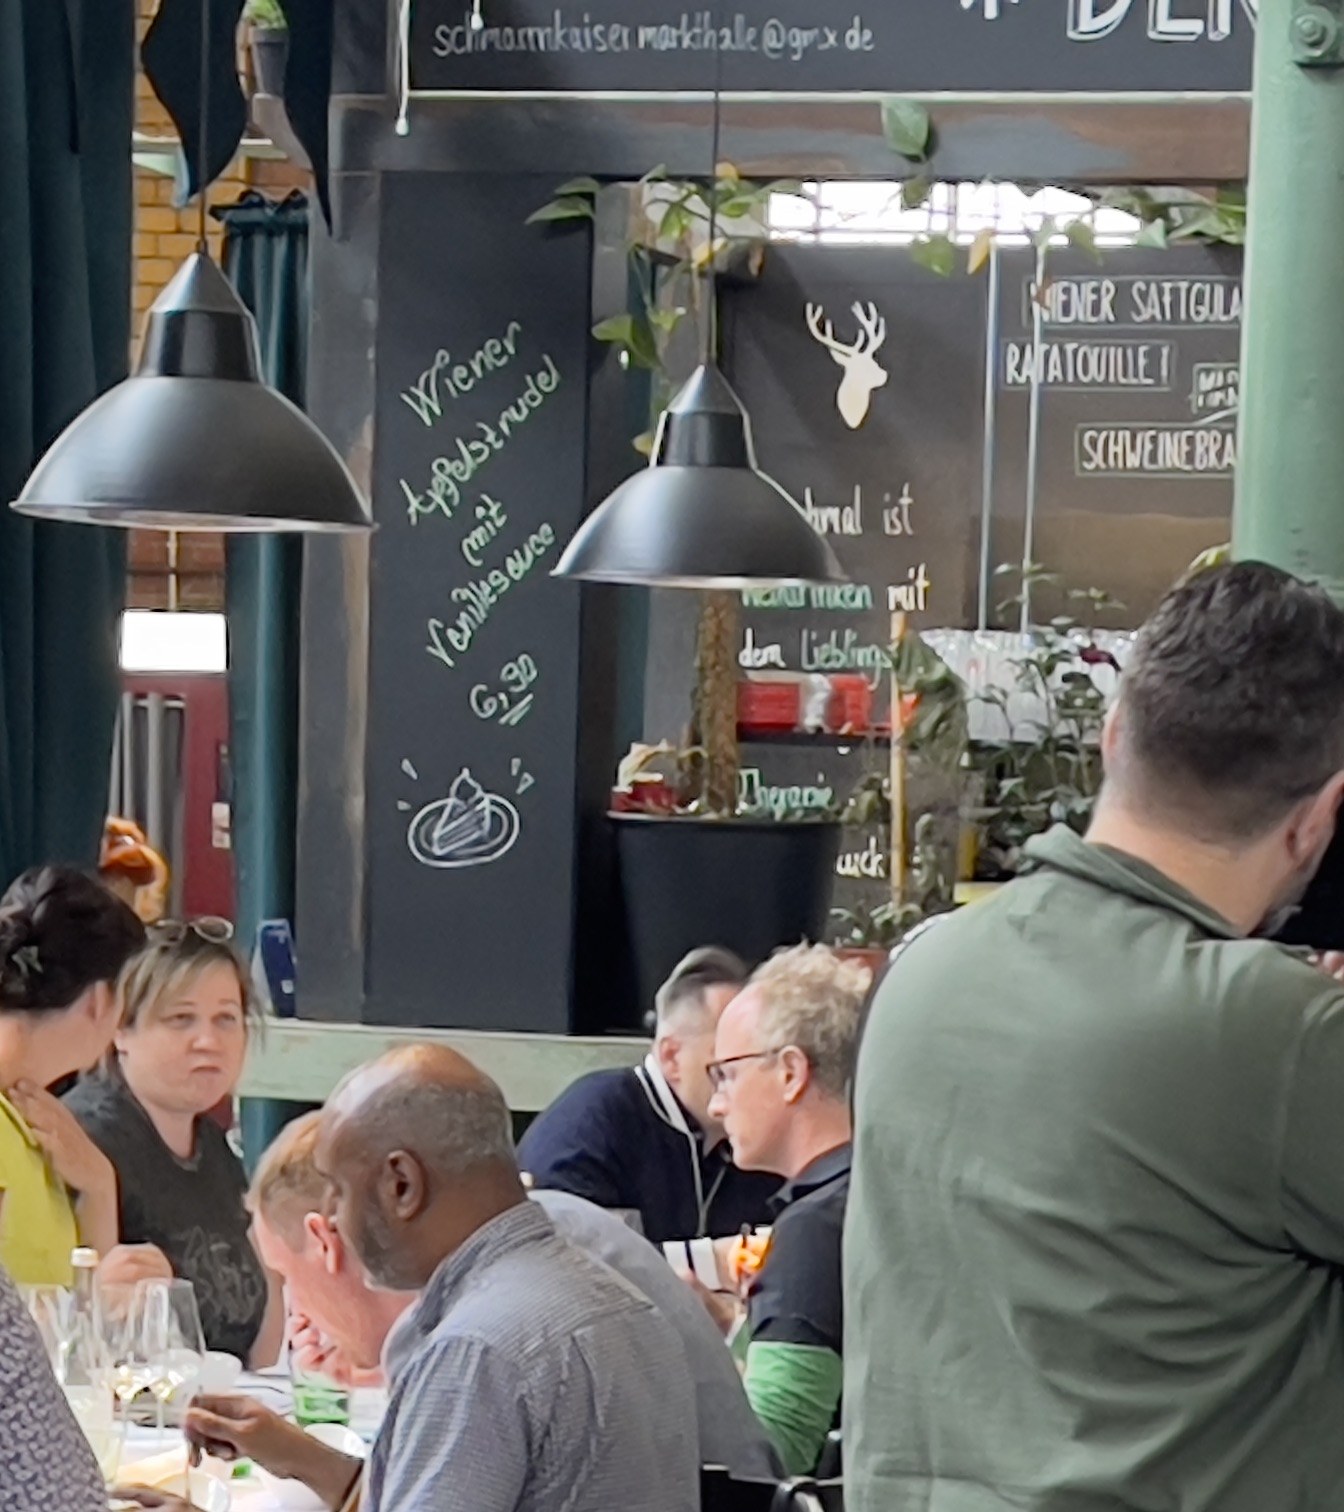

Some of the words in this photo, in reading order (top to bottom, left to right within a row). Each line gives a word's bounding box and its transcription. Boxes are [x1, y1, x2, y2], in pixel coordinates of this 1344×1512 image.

[400, 321, 522, 427] Wiener
[462, 494, 507, 567] mit
[883, 482, 914, 536] ist
[887, 562, 930, 611] mit
